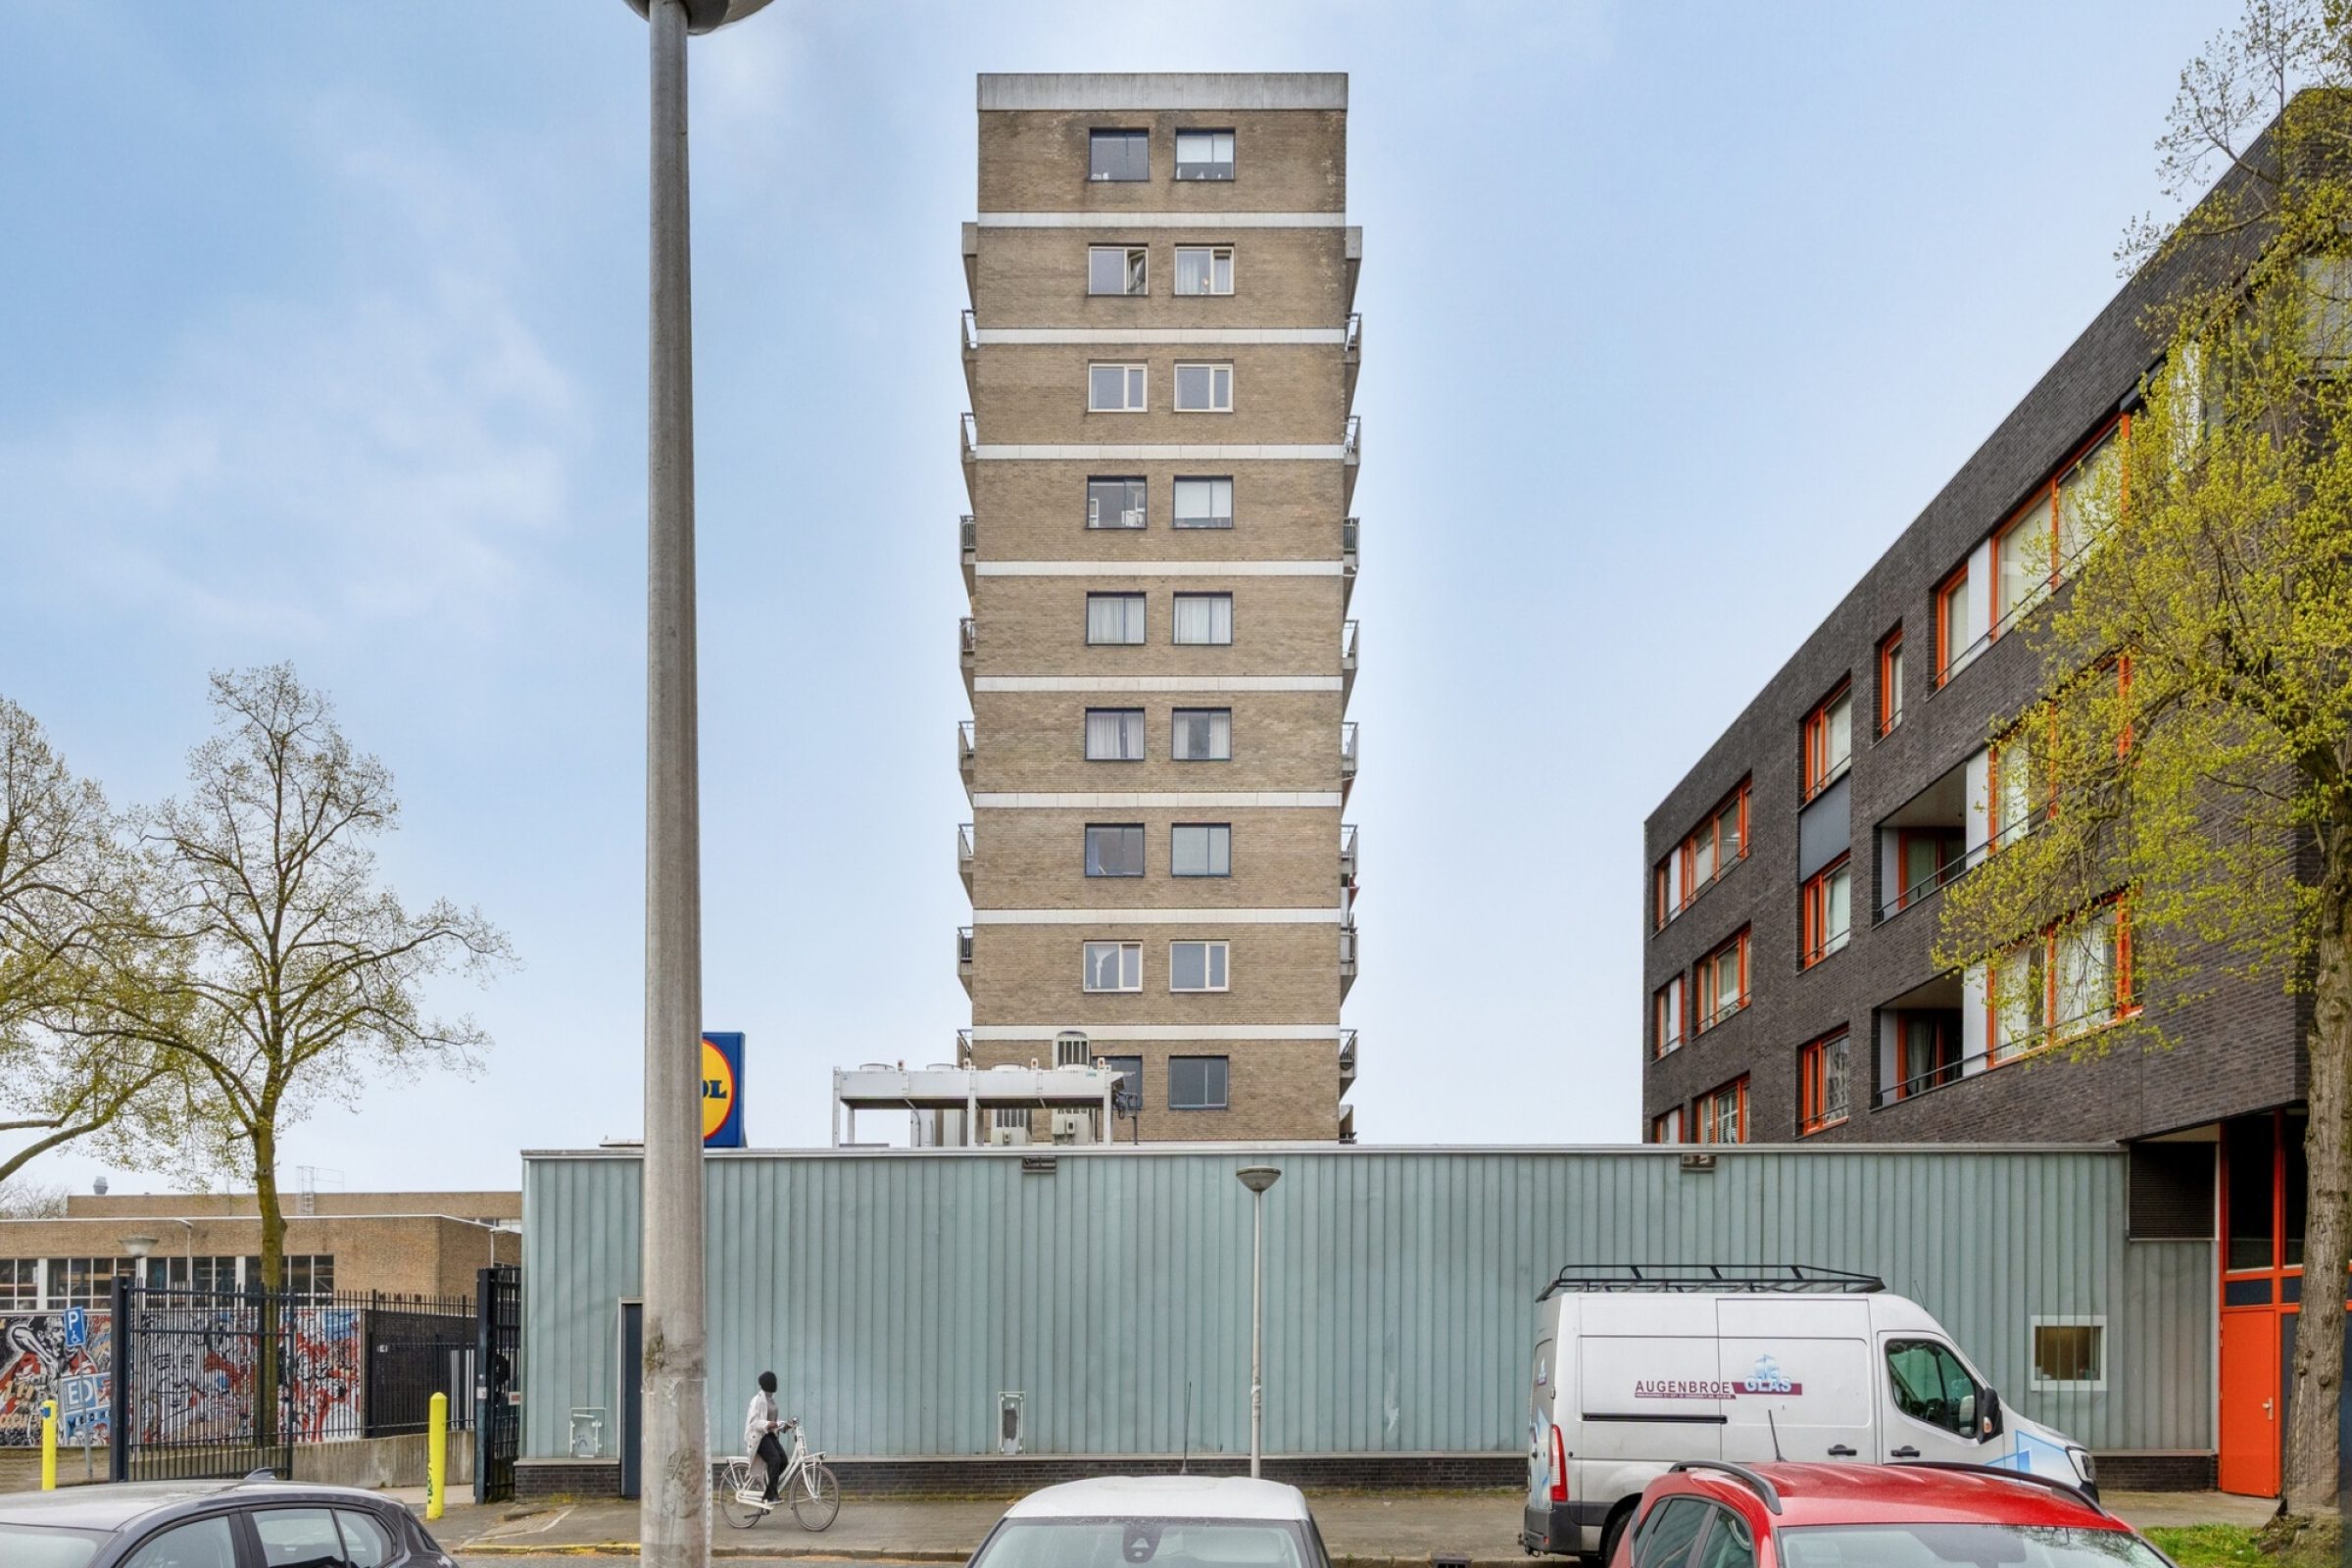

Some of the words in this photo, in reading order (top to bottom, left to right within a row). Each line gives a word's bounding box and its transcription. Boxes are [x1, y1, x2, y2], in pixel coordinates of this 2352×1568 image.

[68, 1311, 78, 1331] P
[1635, 1380, 1731, 1394] AUGENBROE
[1744, 1375, 1792, 1393] GLAS
